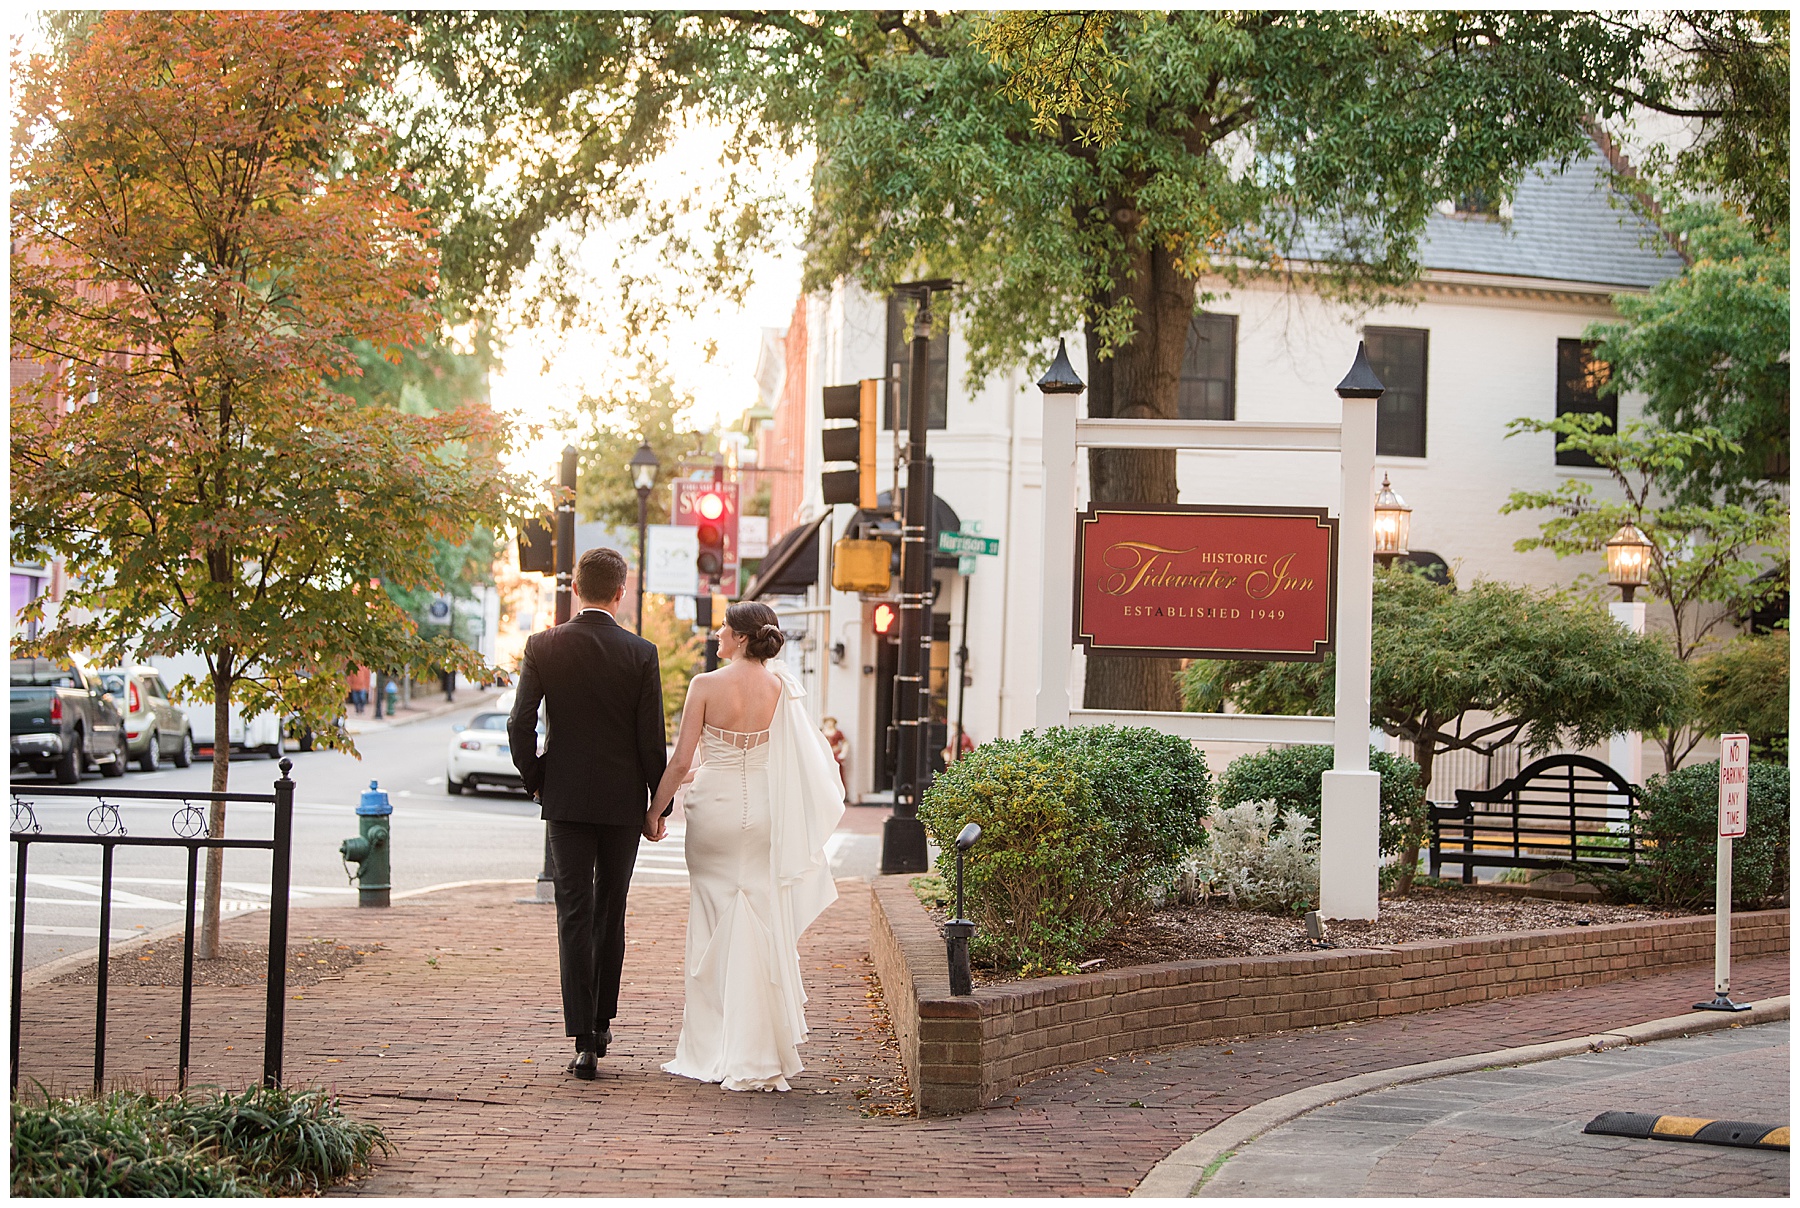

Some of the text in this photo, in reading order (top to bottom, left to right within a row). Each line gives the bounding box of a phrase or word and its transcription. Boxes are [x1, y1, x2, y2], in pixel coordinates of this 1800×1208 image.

[940, 532, 986, 553] Harrison
[1202, 552, 1268, 565] HISTORIC
[1098, 541, 1315, 600] Tidewater Inn
[1123, 605, 1286, 621] ESTABLISHED 1949
[1729, 746, 1739, 761] NO
[1723, 767, 1744, 784] PARKING
[1728, 792, 1739, 806] ANY
[1727, 811, 1739, 825] TIME
